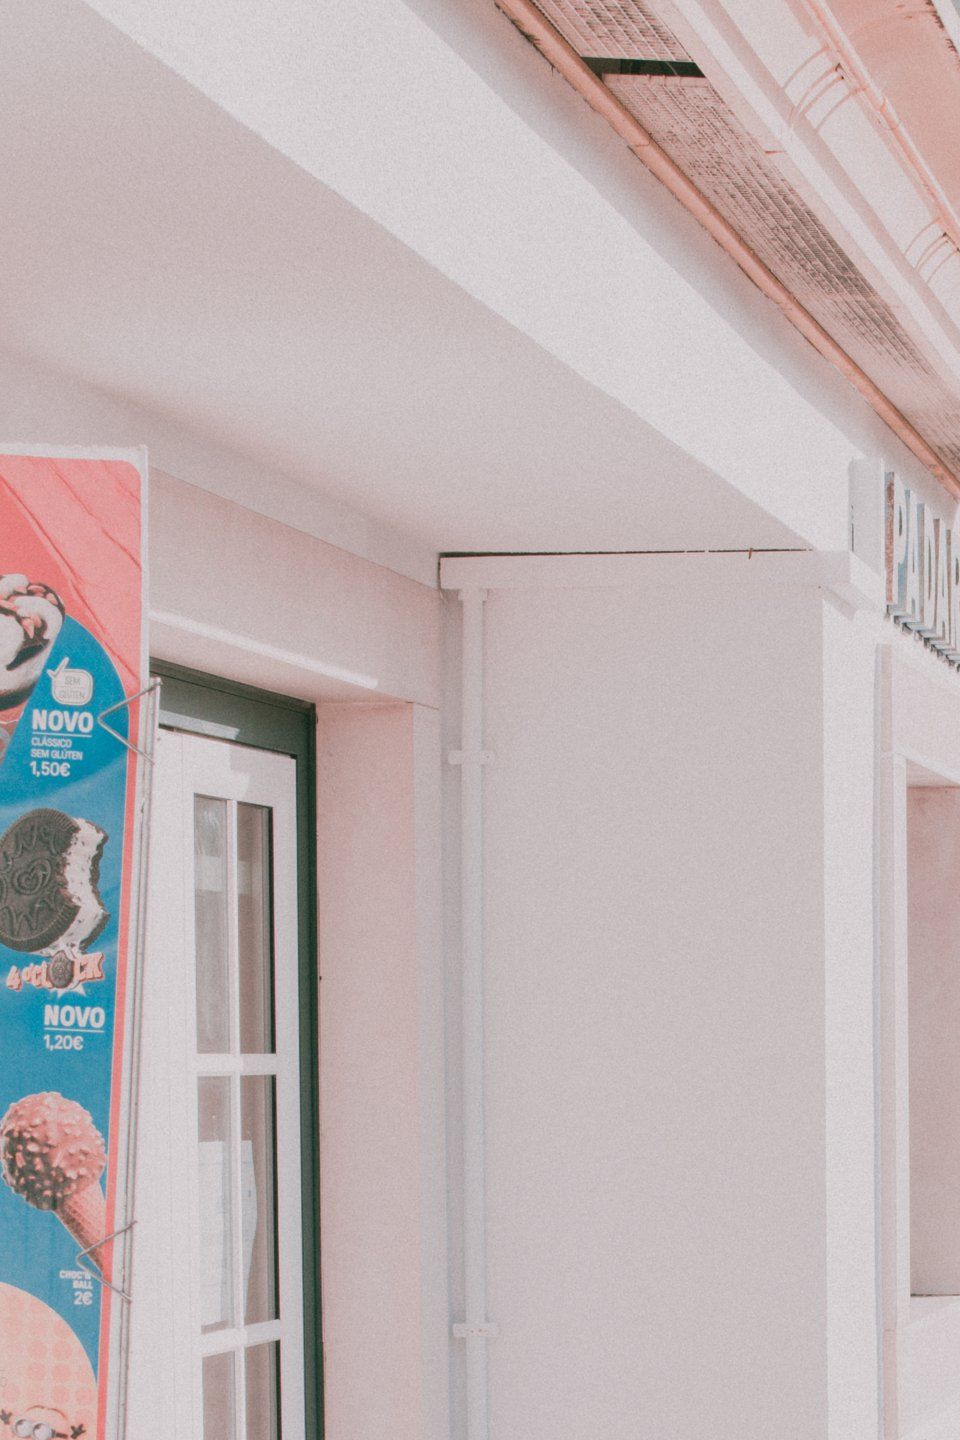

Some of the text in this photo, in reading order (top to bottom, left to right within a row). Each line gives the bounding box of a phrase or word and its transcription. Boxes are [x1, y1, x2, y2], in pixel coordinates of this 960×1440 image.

[32, 709, 94, 734] NOVO
[30, 748, 50, 759] SEM
[30, 761, 71, 777] 1,50€
[44, 1004, 106, 1028] NOVO
[43, 1034, 84, 1051] 1,20€
[73, 1291, 94, 1306] 2€
